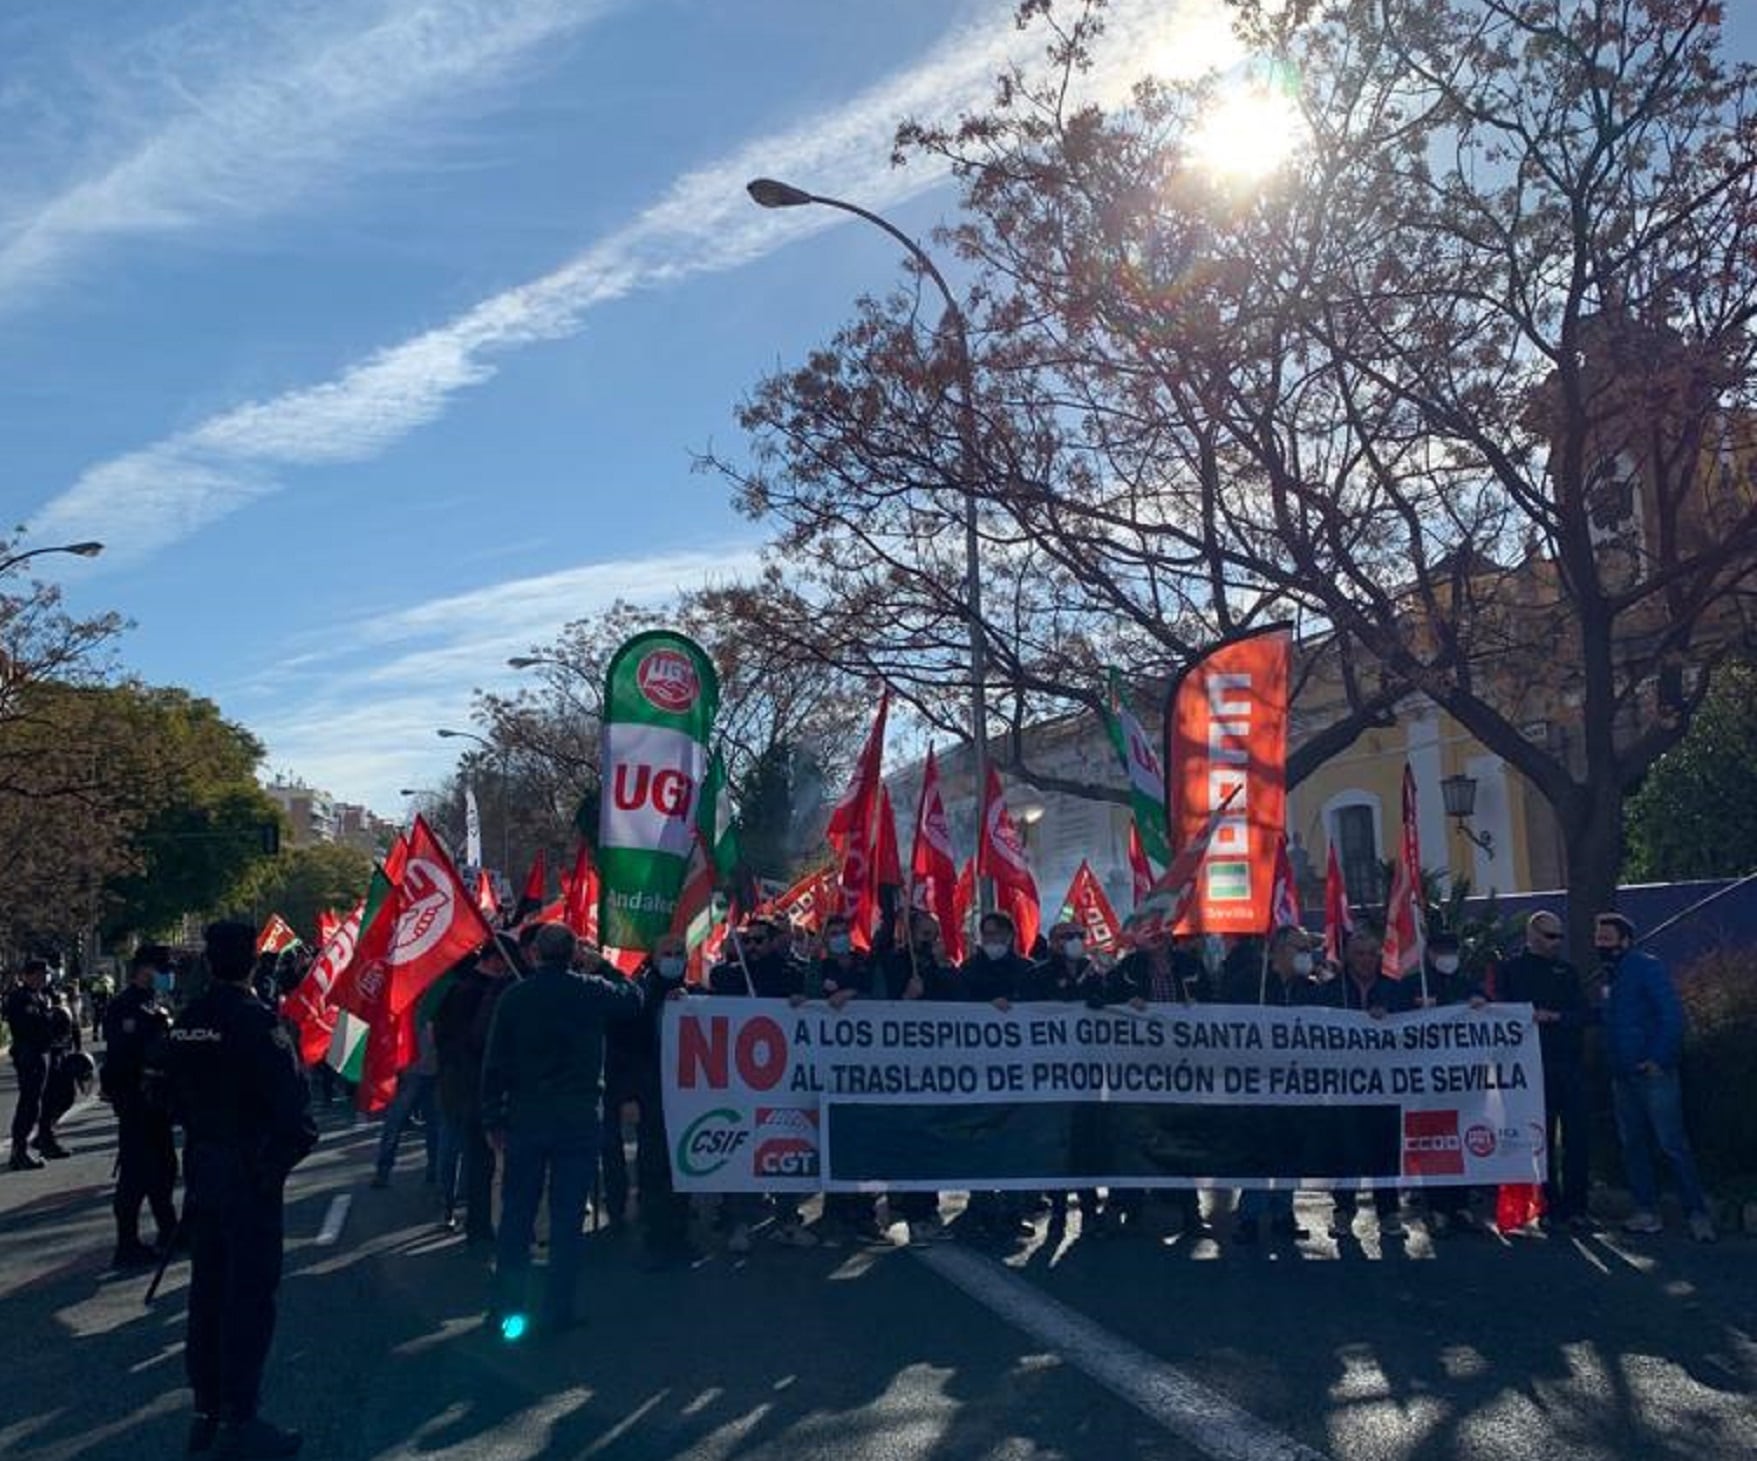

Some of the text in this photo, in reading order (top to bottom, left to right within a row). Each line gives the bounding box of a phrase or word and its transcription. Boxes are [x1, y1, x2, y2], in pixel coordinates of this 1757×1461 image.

[614, 763, 693, 818] UG
[794, 1017, 1524, 1051] A LOS DESPIDOS EN GDELS SANTA BÁRBARA SISTEMAS
[678, 1015, 788, 1092] NO
[791, 1058, 1528, 1095] AL TRASLADO DE PRODUCCIÓN DE FÁBRICA DE SEVILLA
[691, 1130, 749, 1154] CSIF
[762, 1151, 815, 1173] CGT
